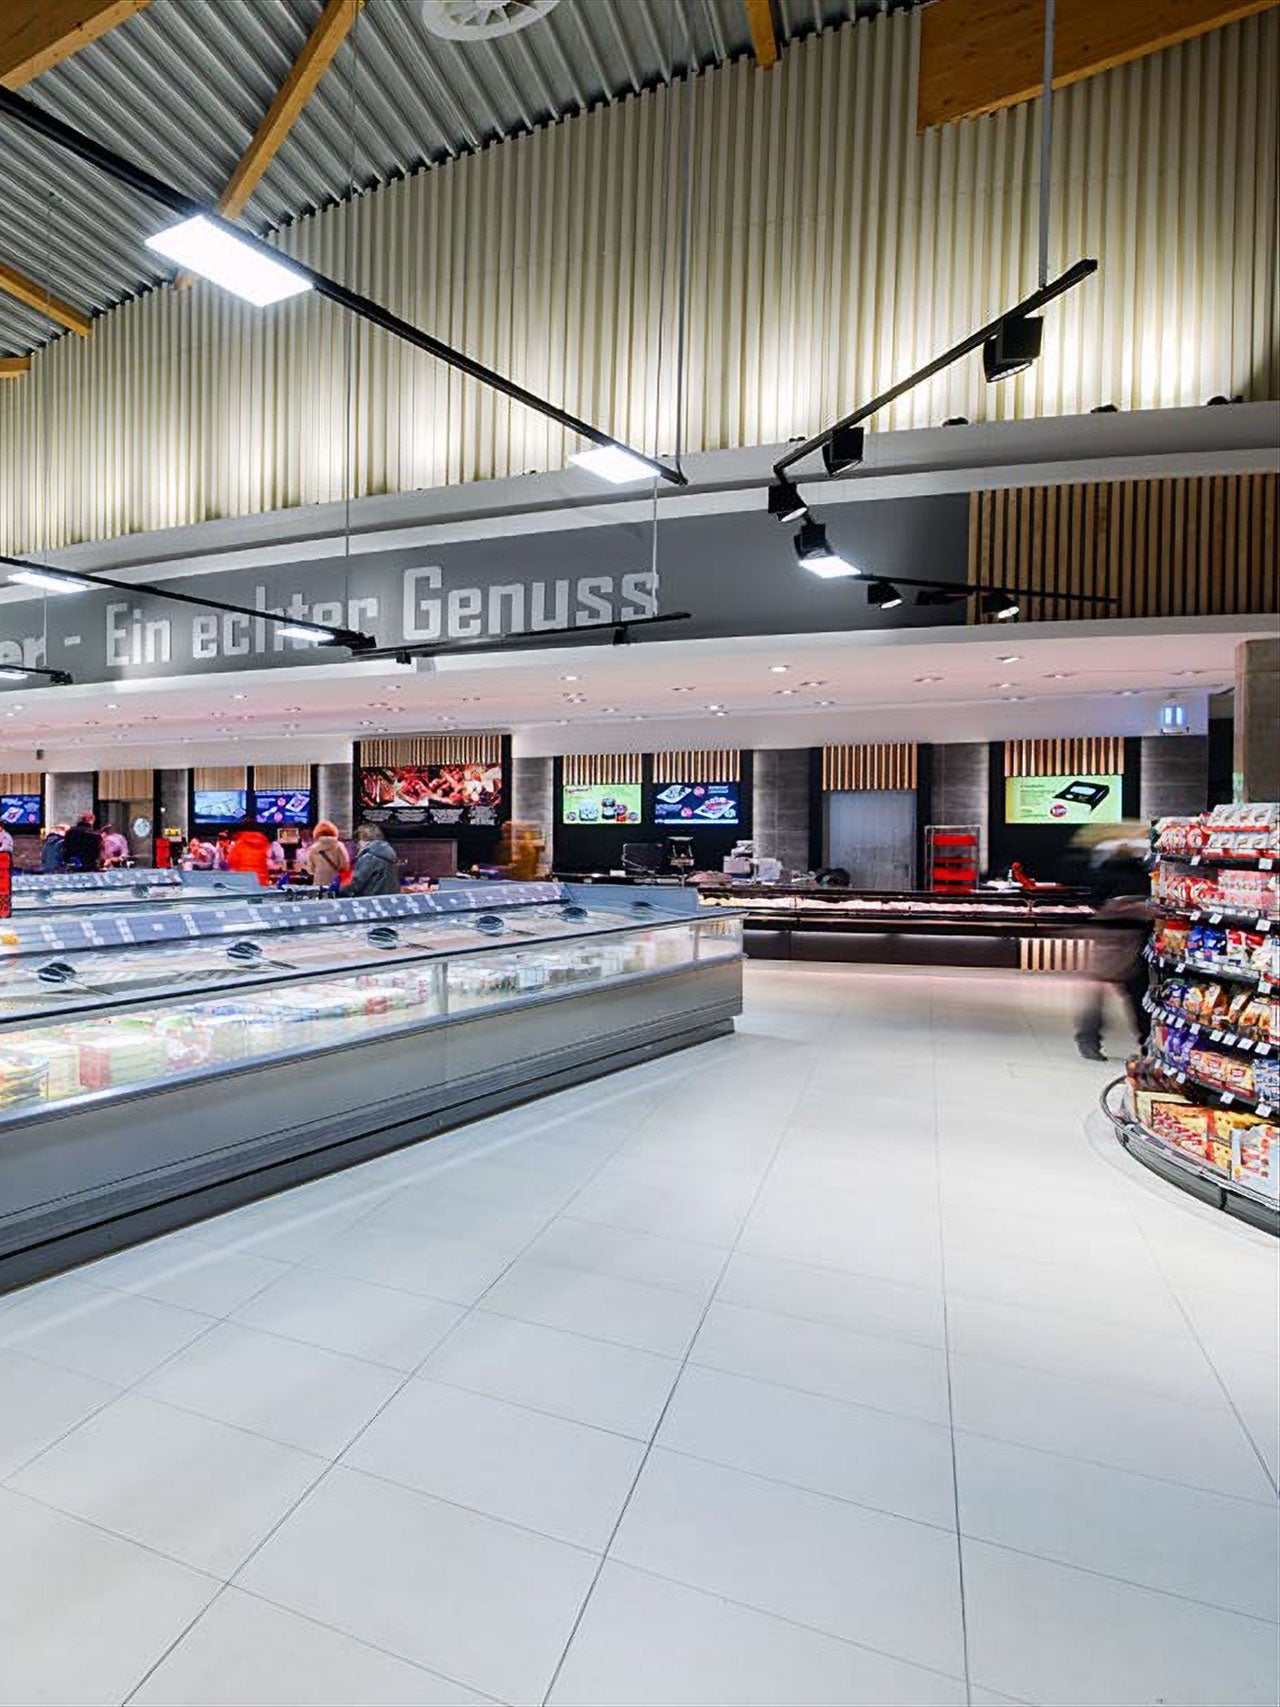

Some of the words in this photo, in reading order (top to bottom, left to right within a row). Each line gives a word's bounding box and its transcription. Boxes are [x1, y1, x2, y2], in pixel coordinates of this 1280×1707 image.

[105, 602, 171, 666] Ein
[192, 585, 378, 658] echter
[402, 566, 659, 640] Genuss
